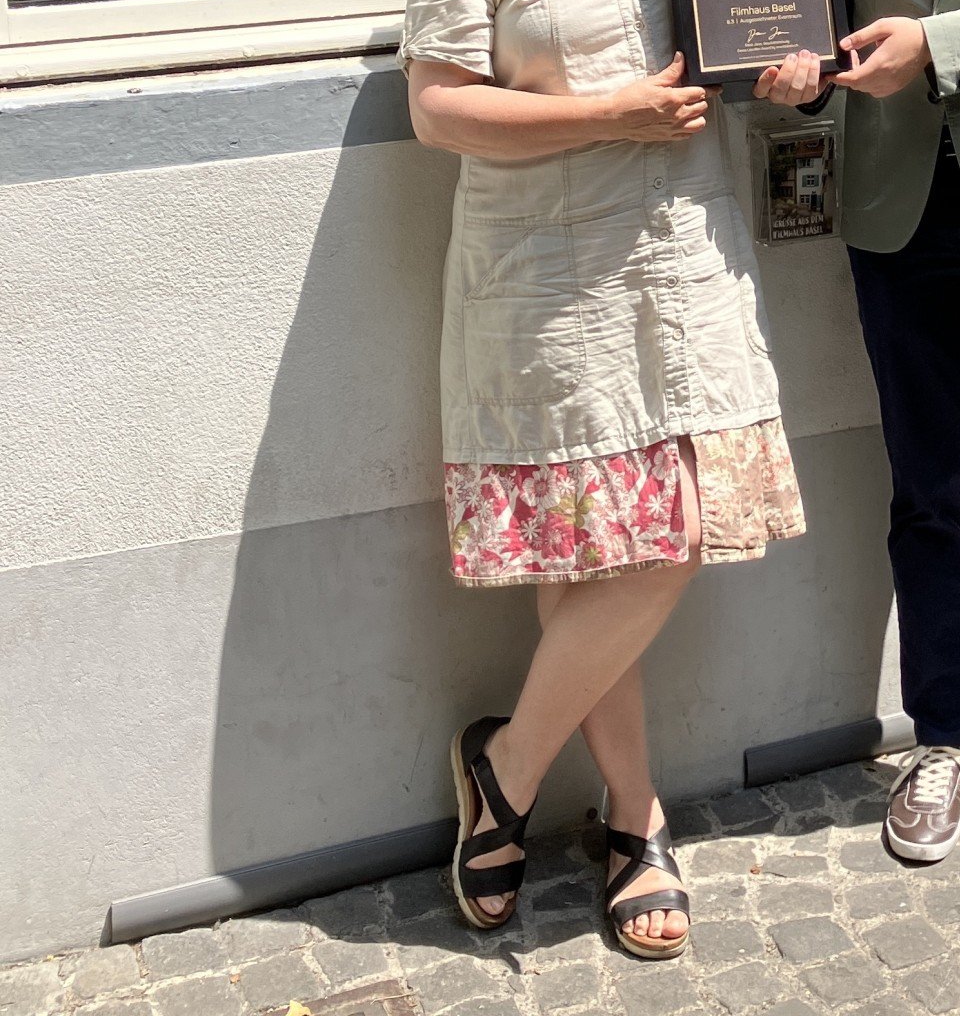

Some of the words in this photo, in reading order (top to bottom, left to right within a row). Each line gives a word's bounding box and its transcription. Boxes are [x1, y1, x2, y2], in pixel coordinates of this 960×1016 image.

[730, 5, 770, 17] Filmhaus
[771, 2, 796, 13] Basel
[805, 224, 823, 236] BASEL
